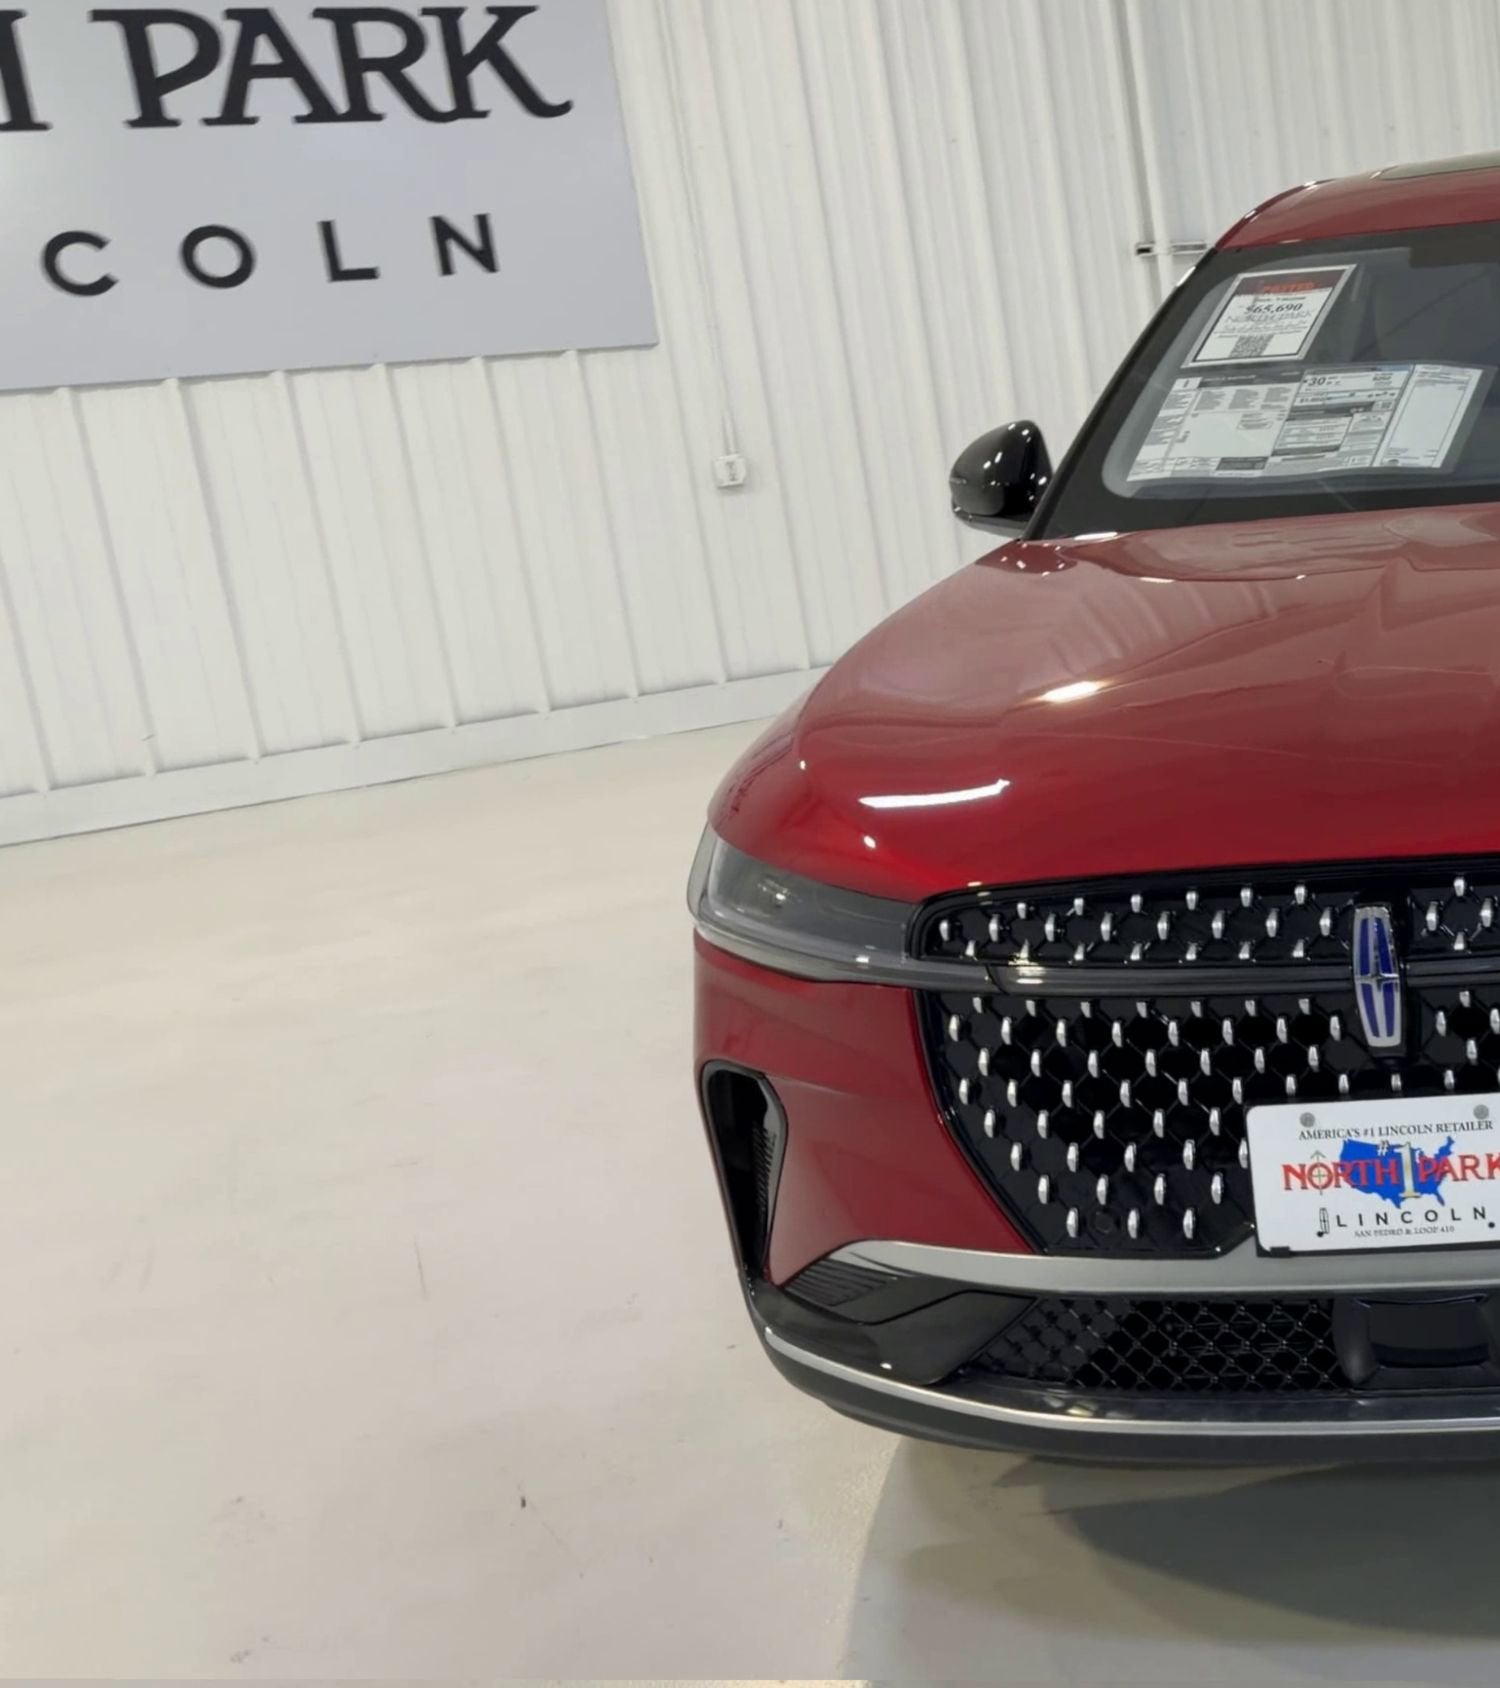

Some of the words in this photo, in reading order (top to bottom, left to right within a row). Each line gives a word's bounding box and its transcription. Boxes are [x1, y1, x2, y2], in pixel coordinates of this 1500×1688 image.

[89, 5, 574, 128] PARK
[40, 213, 502, 297] COLN
[1298, 1127, 1361, 1141] AMERICA'S
[1363, 1127, 1375, 1138] #1
[1378, 1123, 1434, 1137] LINCOLN
[1436, 1119, 1494, 1134] RETAILER
[1281, 1157, 1400, 1191] NORTH
[1336, 1206, 1488, 1228] LINCOLN
[1354, 1229, 1371, 1238] SAN
[1374, 1228, 1403, 1237] PEDRO
[1414, 1226, 1438, 1235] LOOP
[1440, 1225, 1455, 1233] 410
